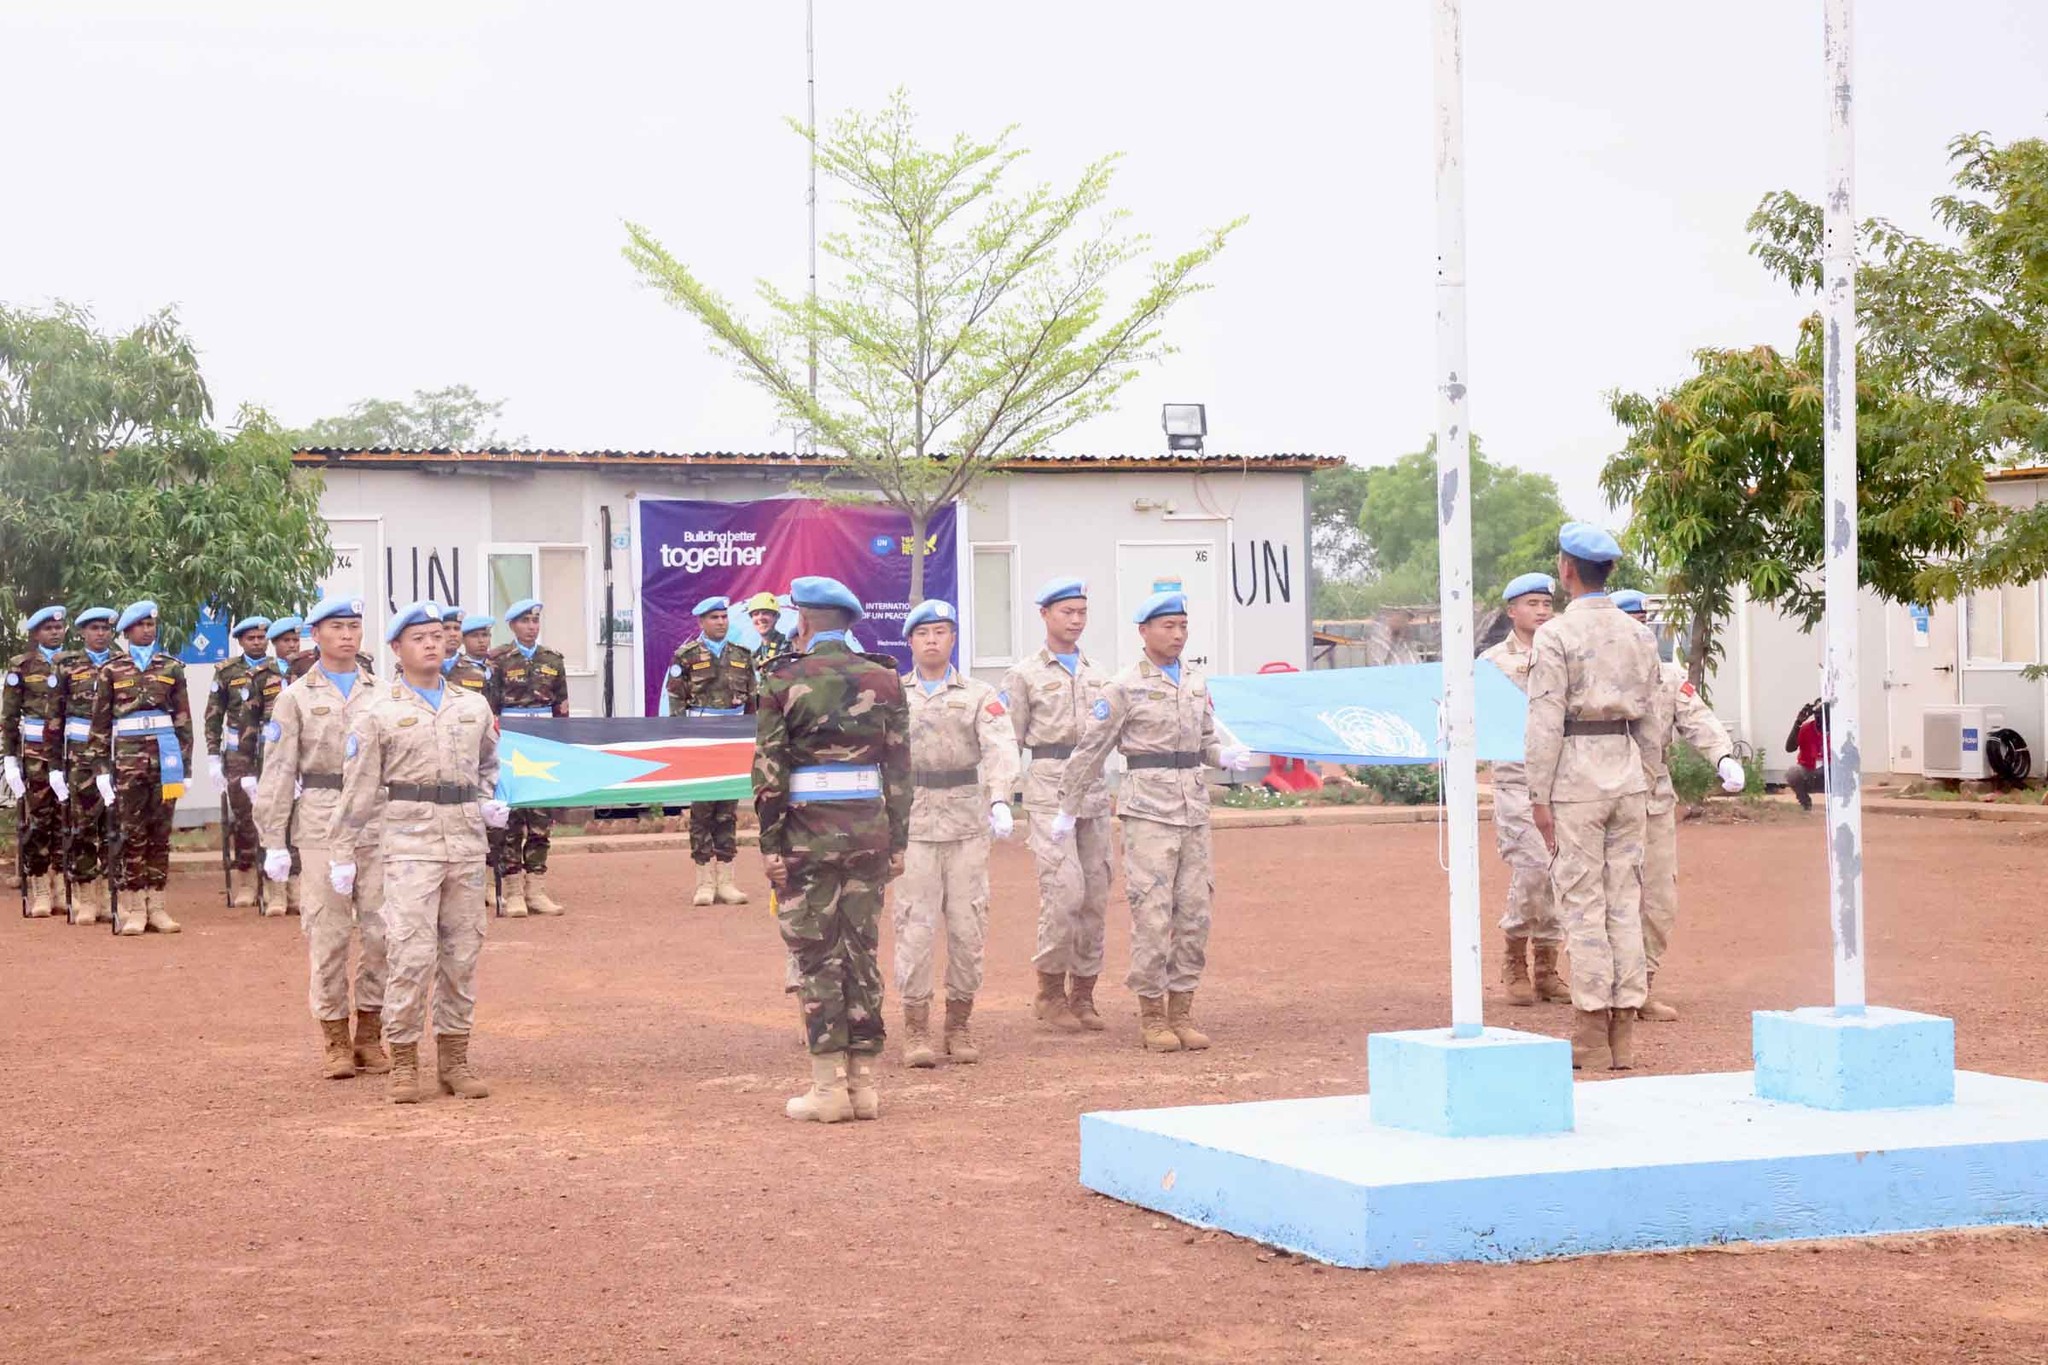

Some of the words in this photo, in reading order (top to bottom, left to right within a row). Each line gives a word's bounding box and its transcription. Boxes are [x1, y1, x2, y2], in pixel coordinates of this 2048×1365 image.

[684, 531, 727, 545] Building
[727, 530, 757, 542] better
[877, 539, 888, 547] UN
[337, 555, 352, 569] X4
[660, 541, 767, 573] together
[1195, 550, 1208, 563] X6
[1231, 540, 1291, 606] UN
[386, 547, 459, 614] UN
[865, 602, 910, 610] INTERNATIO
[872, 612, 884, 620] UN
[885, 612, 909, 620] PEACE
